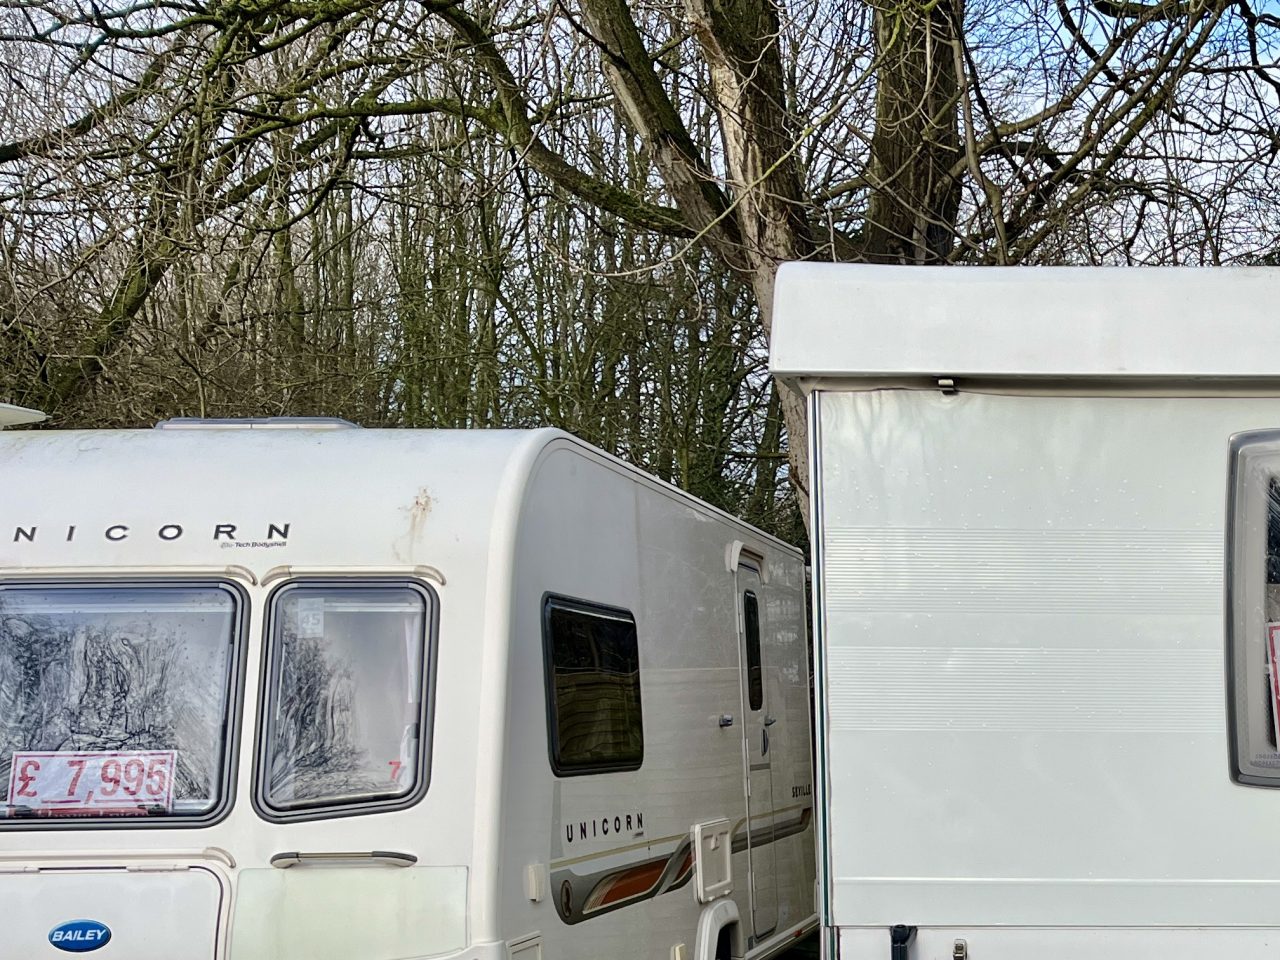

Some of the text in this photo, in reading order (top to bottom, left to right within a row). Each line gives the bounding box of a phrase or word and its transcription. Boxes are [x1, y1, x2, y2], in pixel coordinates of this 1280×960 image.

[17, 758, 167, 805] £ 7,995
[388, 761, 402, 780] 7
[566, 813, 643, 843] UNICORN
[52, 929, 107, 942] BAILEY
